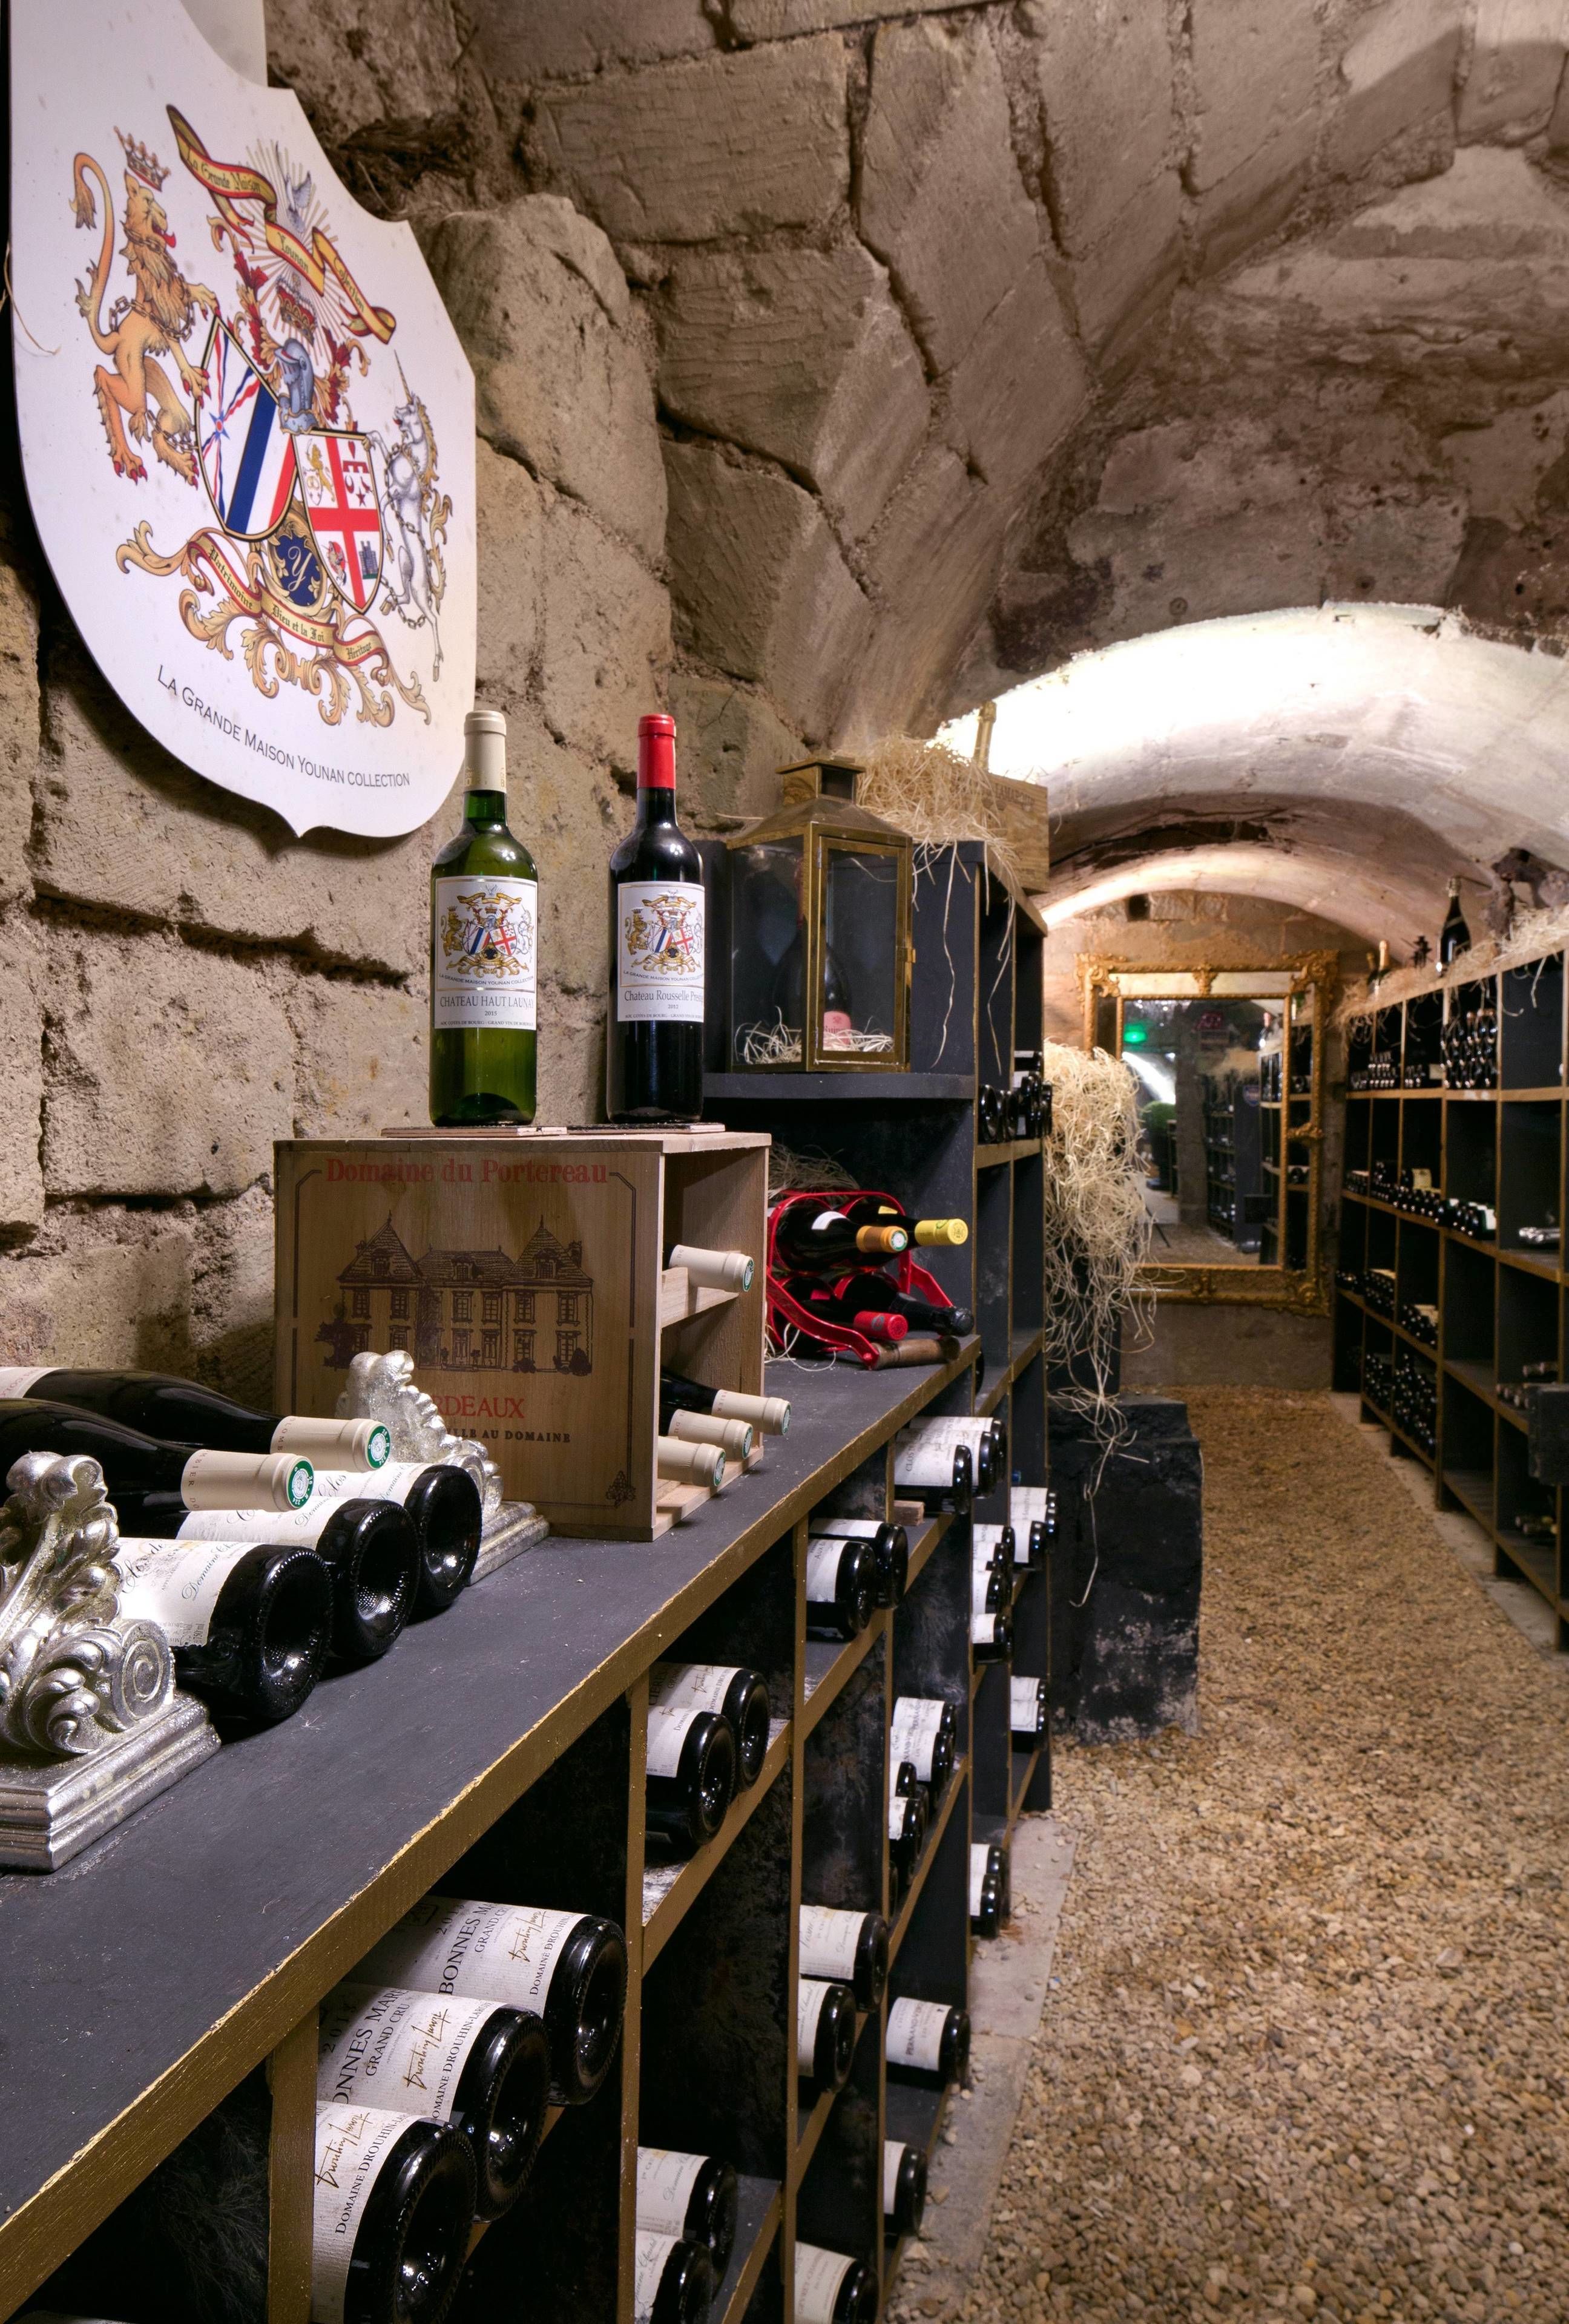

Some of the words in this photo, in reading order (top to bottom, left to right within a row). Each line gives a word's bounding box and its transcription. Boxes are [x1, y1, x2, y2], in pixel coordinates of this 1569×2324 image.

[277, 232, 309, 272] Younan
[209, 547, 253, 609] Patrimoine
[272, 604, 291, 627] Dieu
[292, 620, 300, 631] et
[300, 623, 309, 636] la
[158, 665, 177, 695] LA
[182, 687, 241, 741] GRANDE
[245, 729, 295, 769] MAISON
[298, 755, 344, 784] YOUNAN
[347, 772, 410, 787] COLLECTION
[439, 996, 479, 1008] CHATEAU
[481, 996, 506, 1007] HAUT
[624, 990, 654, 1001] Chateau
[656, 990, 689, 1000] Rousselle
[326, 1157, 434, 1182] Domaine
[441, 1158, 473, 1183] du
[481, 1158, 608, 1184] Portereau
[432, 1394, 525, 1419] RDEAUX
[482, 1429, 499, 1439] AU
[504, 1430, 571, 1443] DOMAINE
[182, 1554, 220, 1601] Domaine
[438, 1918, 481, 1995] BONNES
[475, 1917, 499, 1953] GRAND
[530, 1949, 551, 1995] DOMAINE
[332, 2027, 373, 2104] ONNES
[364, 1988, 409, 2023] MARE
[366, 2026, 393, 2076] GRAND
[389, 2003, 410, 2023] CRU
[433, 2075, 450, 2119] OMAINE
[335, 2175, 366, 2234] DOMAINE
